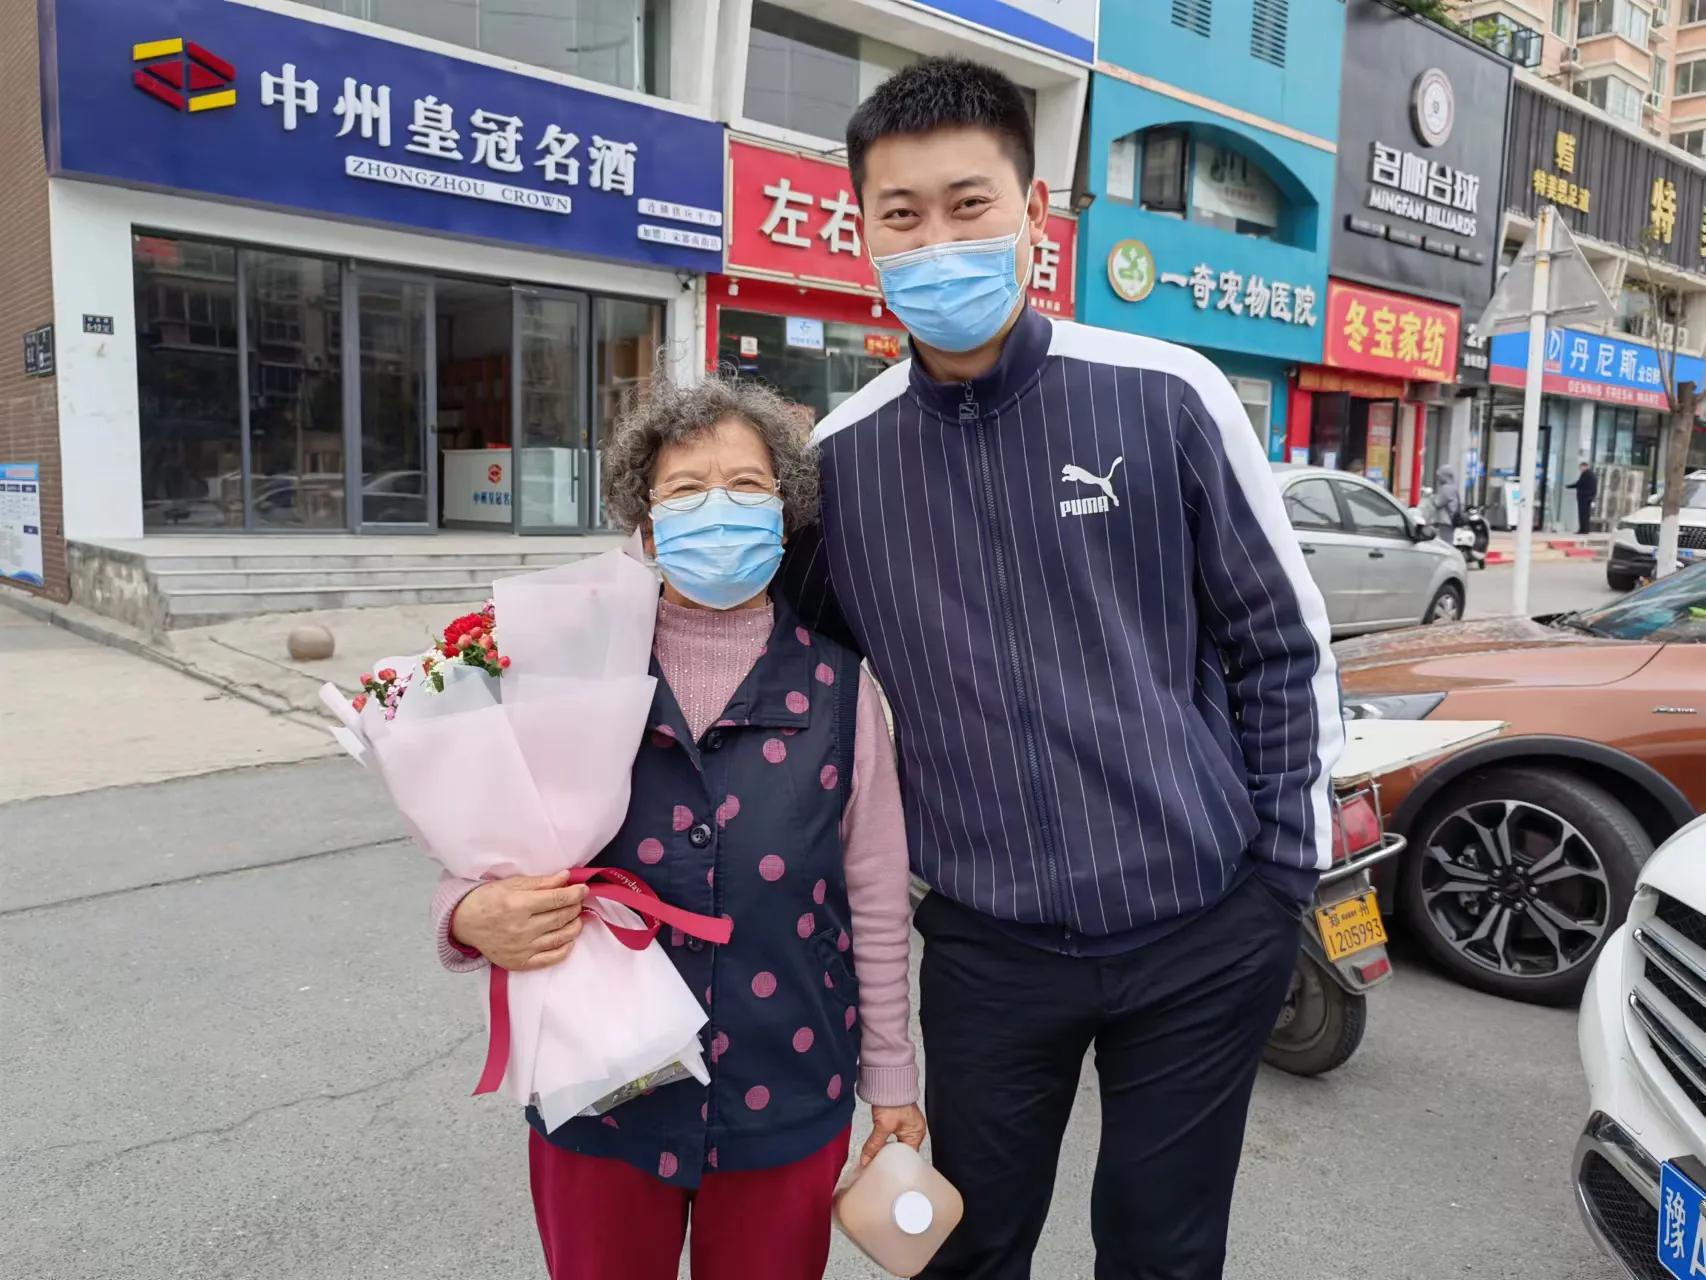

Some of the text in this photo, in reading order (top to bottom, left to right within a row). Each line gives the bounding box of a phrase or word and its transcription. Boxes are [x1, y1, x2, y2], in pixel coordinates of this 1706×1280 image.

[260, 62, 637, 196] 中州皇冠名酒
[351, 159, 569, 212] ZHONGZHOU CROWN
[1369, 186, 1425, 222] MINGFAN
[1425, 204, 1477, 238] BILLIARDS
[1160, 263, 1317, 328] 一奇宠物医院
[1343, 299, 1446, 368] 冬宝家纺
[1570, 336, 1638, 381] 丹尼斯
[1060, 495, 1109, 517] PUMA
